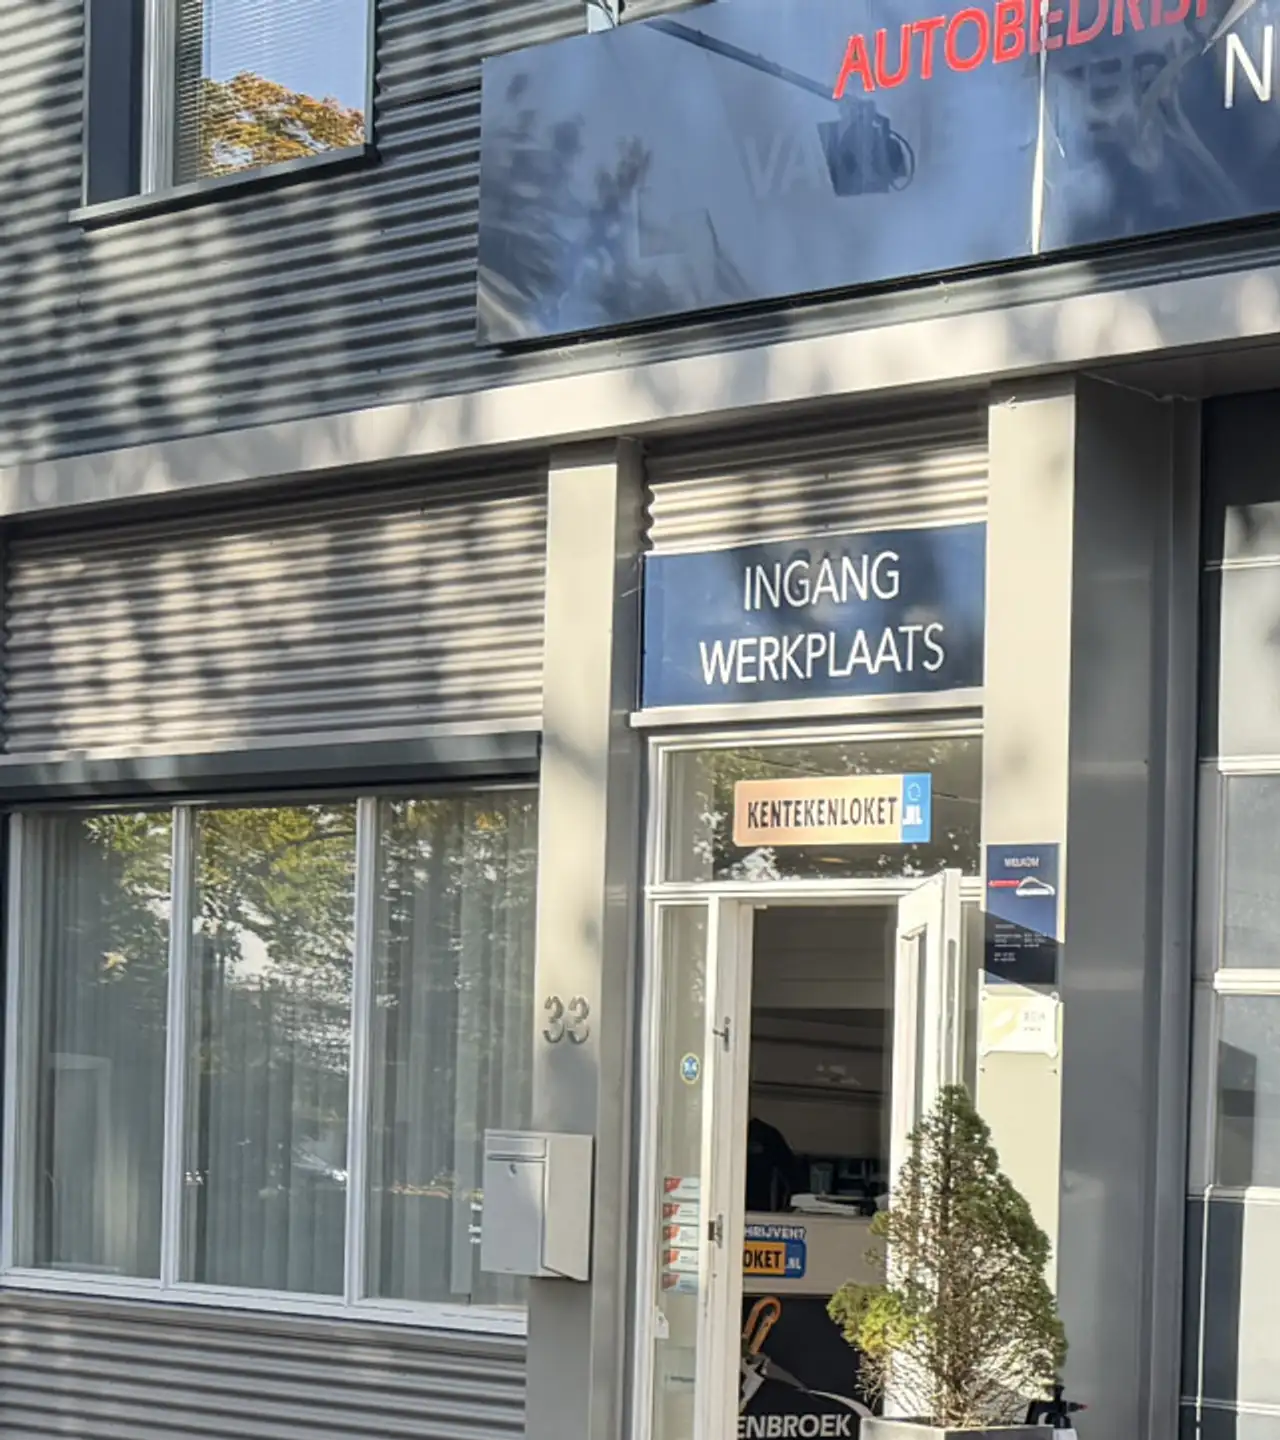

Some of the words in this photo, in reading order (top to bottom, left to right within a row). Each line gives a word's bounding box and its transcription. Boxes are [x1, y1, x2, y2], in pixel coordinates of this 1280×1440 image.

[832, 0, 1208, 99] AUTOBEDR
[744, 551, 900, 611] INGANG
[699, 622, 945, 685] WERKPLAATS
[747, 797, 898, 828] KENTEKENLOKET
[543, 995, 590, 1044] 33
